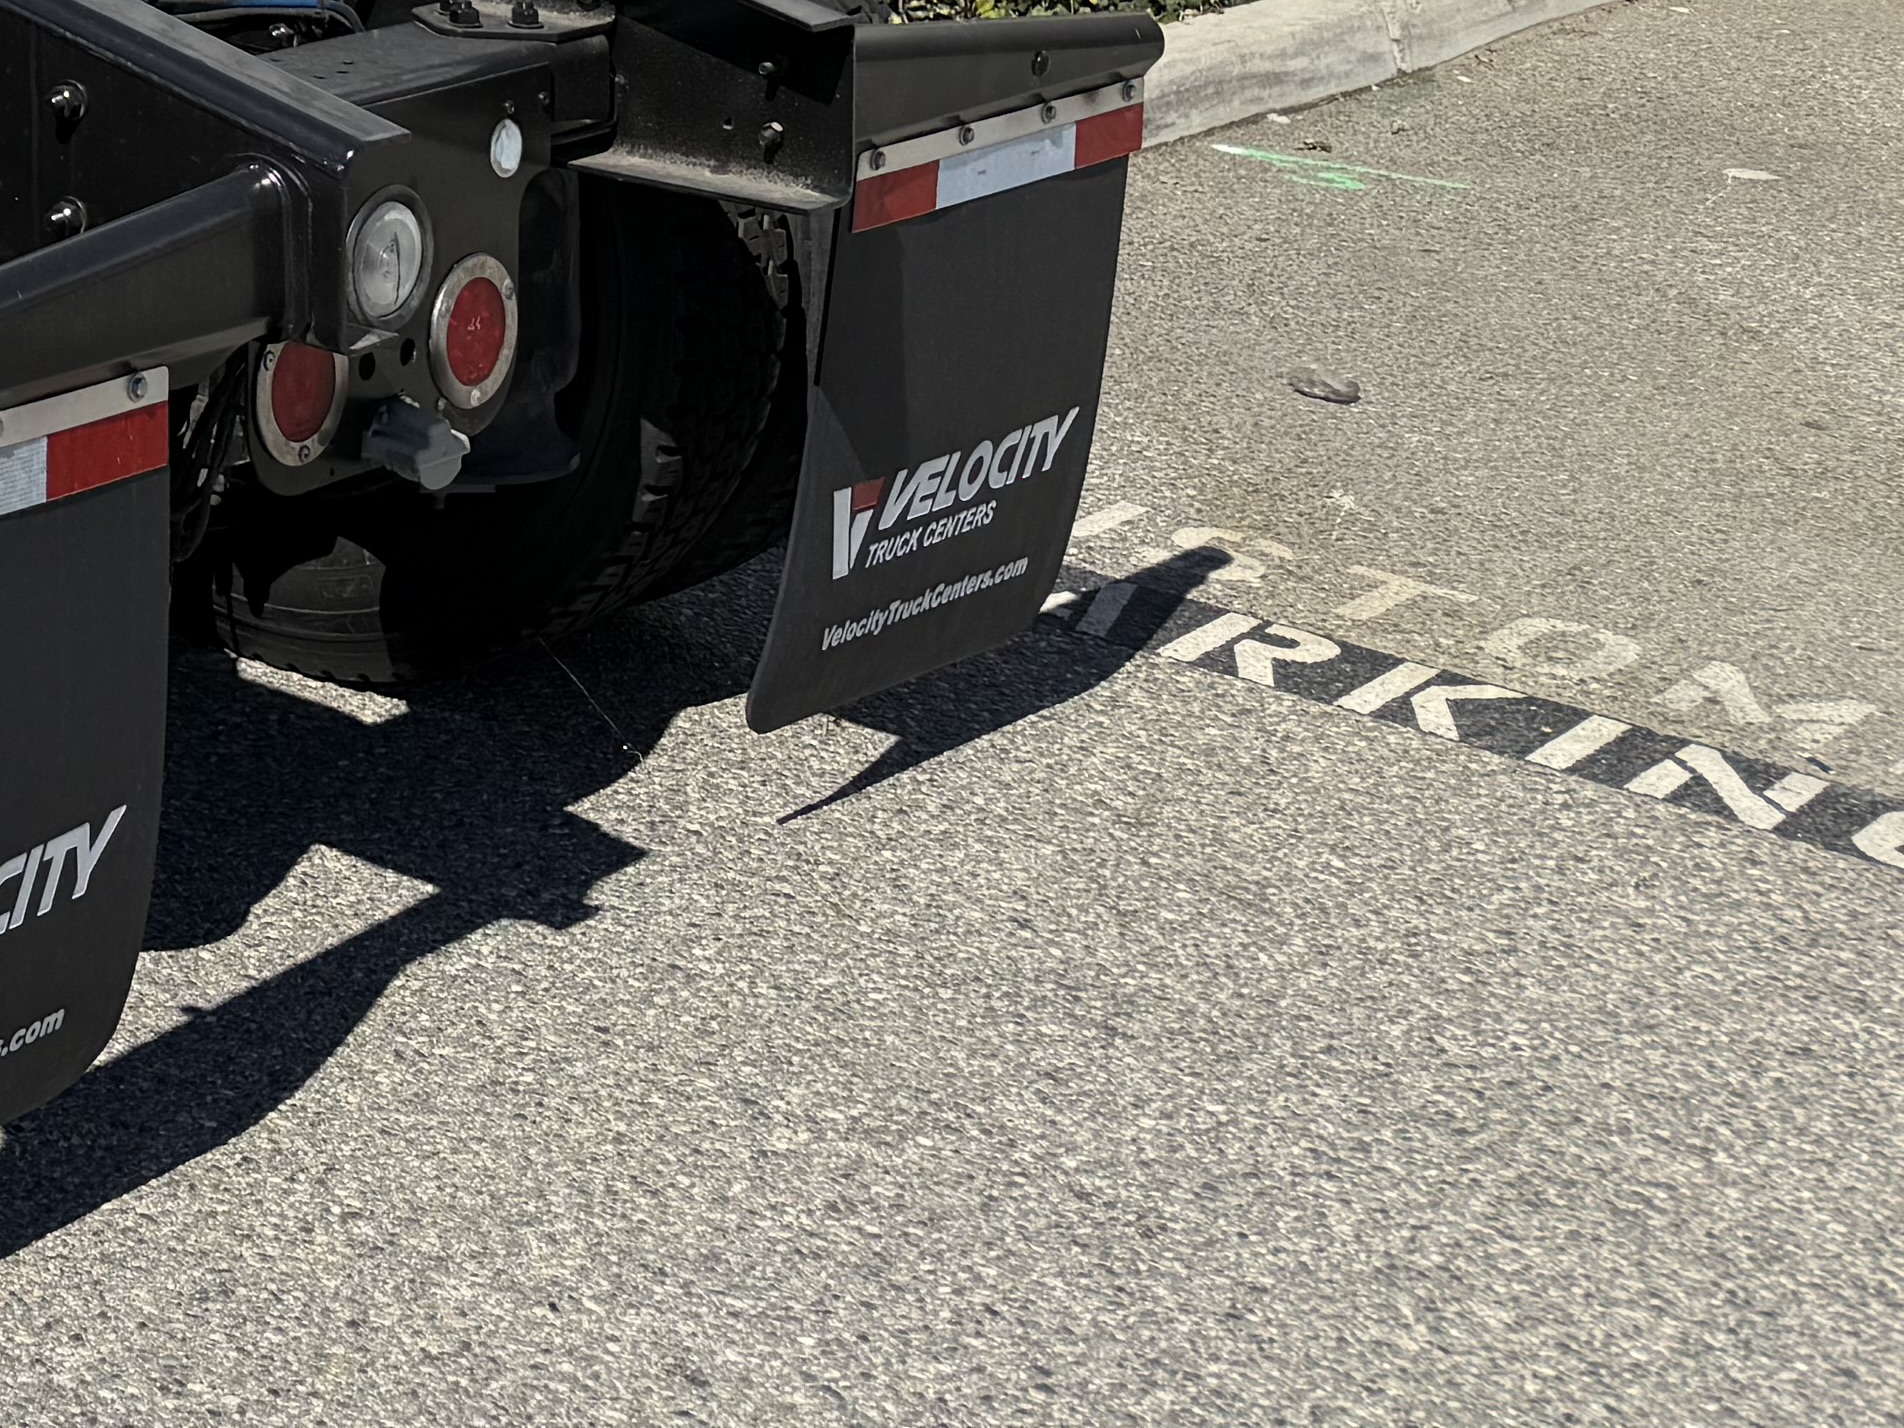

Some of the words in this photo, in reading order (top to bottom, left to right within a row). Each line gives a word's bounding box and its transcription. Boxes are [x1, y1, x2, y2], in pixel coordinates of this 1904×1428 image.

[878, 406, 1080, 531] VELOCITY
[865, 527, 924, 568] TRUCK
[923, 500, 997, 546] CENTERS
[821, 556, 1029, 651] VelocityTruckCenters.com
